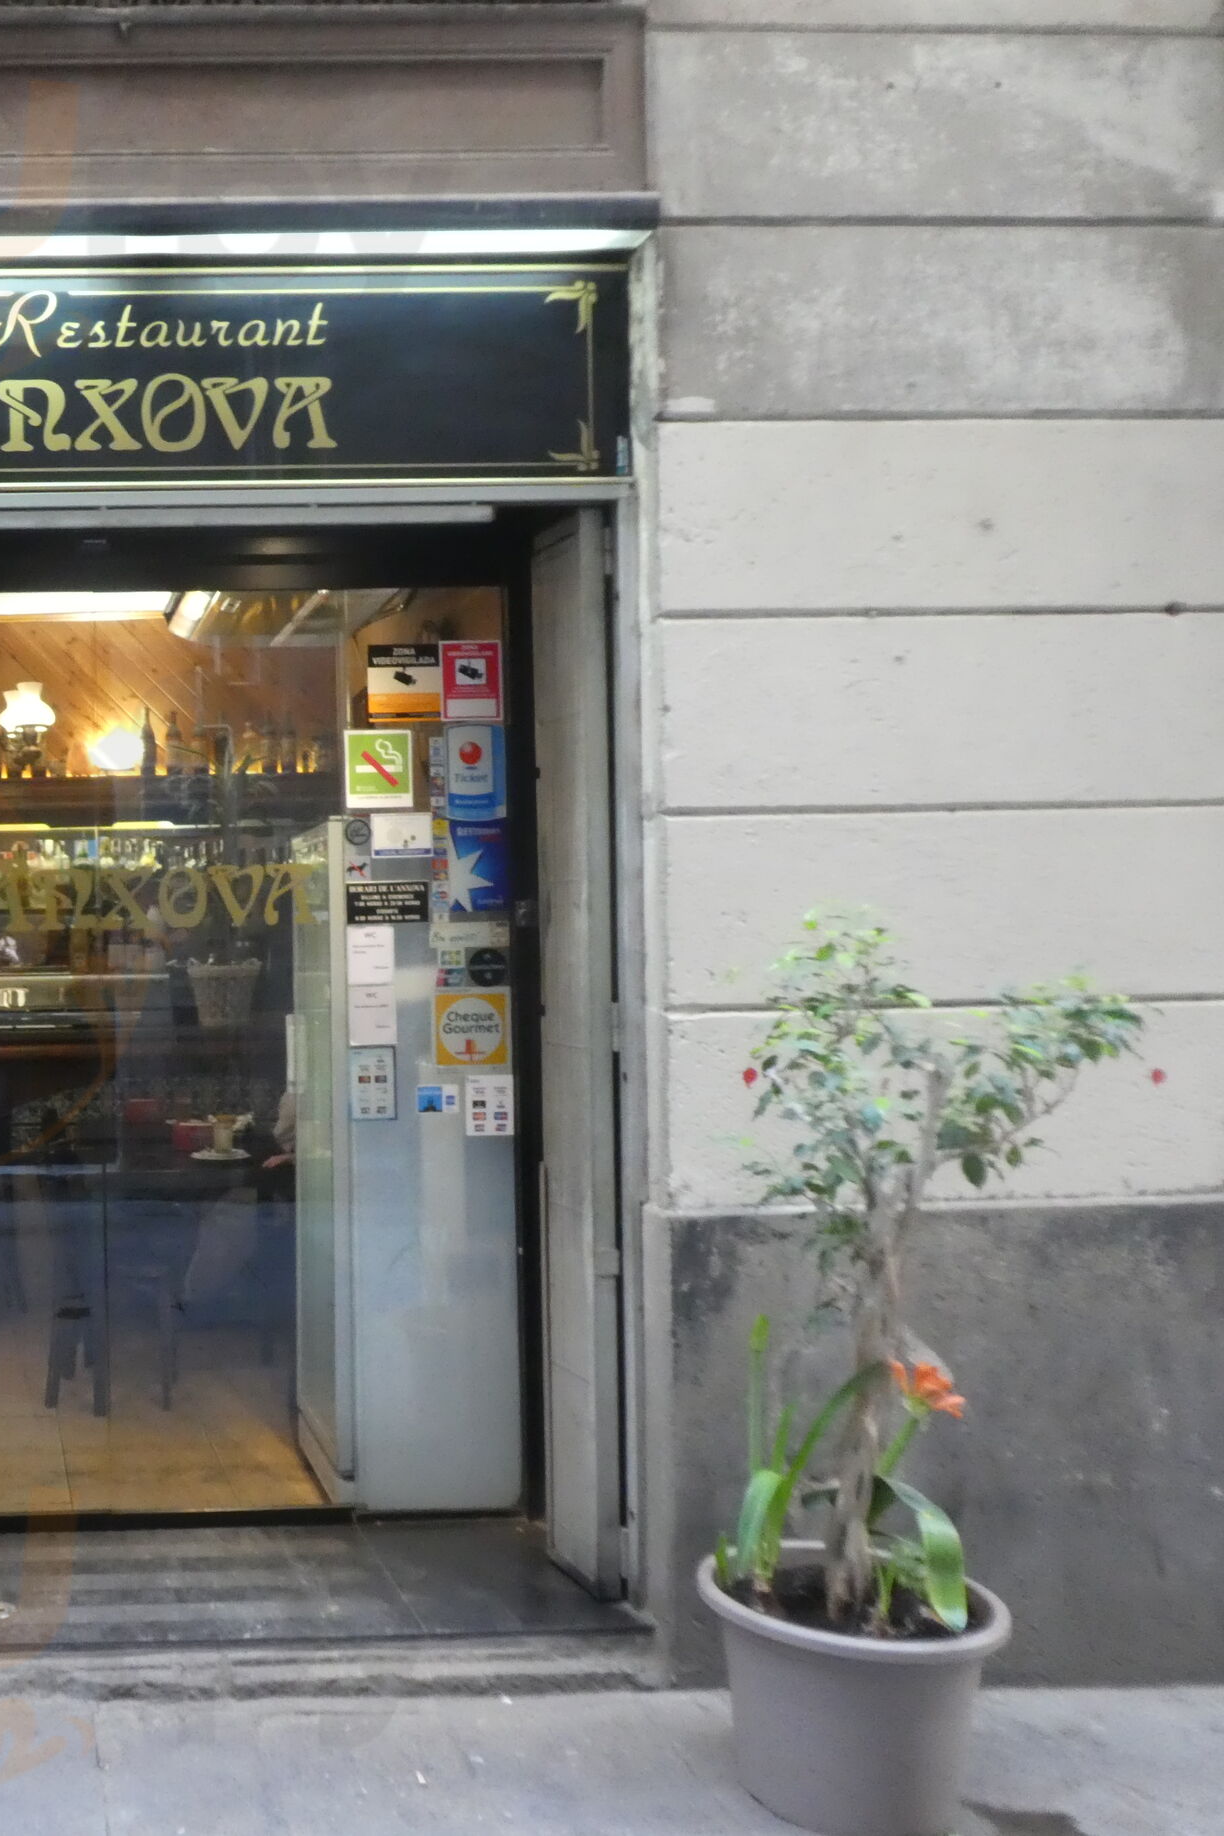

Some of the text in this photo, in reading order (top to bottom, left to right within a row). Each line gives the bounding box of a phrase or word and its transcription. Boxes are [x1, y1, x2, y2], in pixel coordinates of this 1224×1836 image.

[393, 647, 416, 656] ZONA
[372, 655, 436, 665] VIDEOVIGILADA
[455, 773, 489, 783] Ticket
[446, 1011, 495, 1023] Cheque
[442, 1023, 500, 1034] Gourmet
